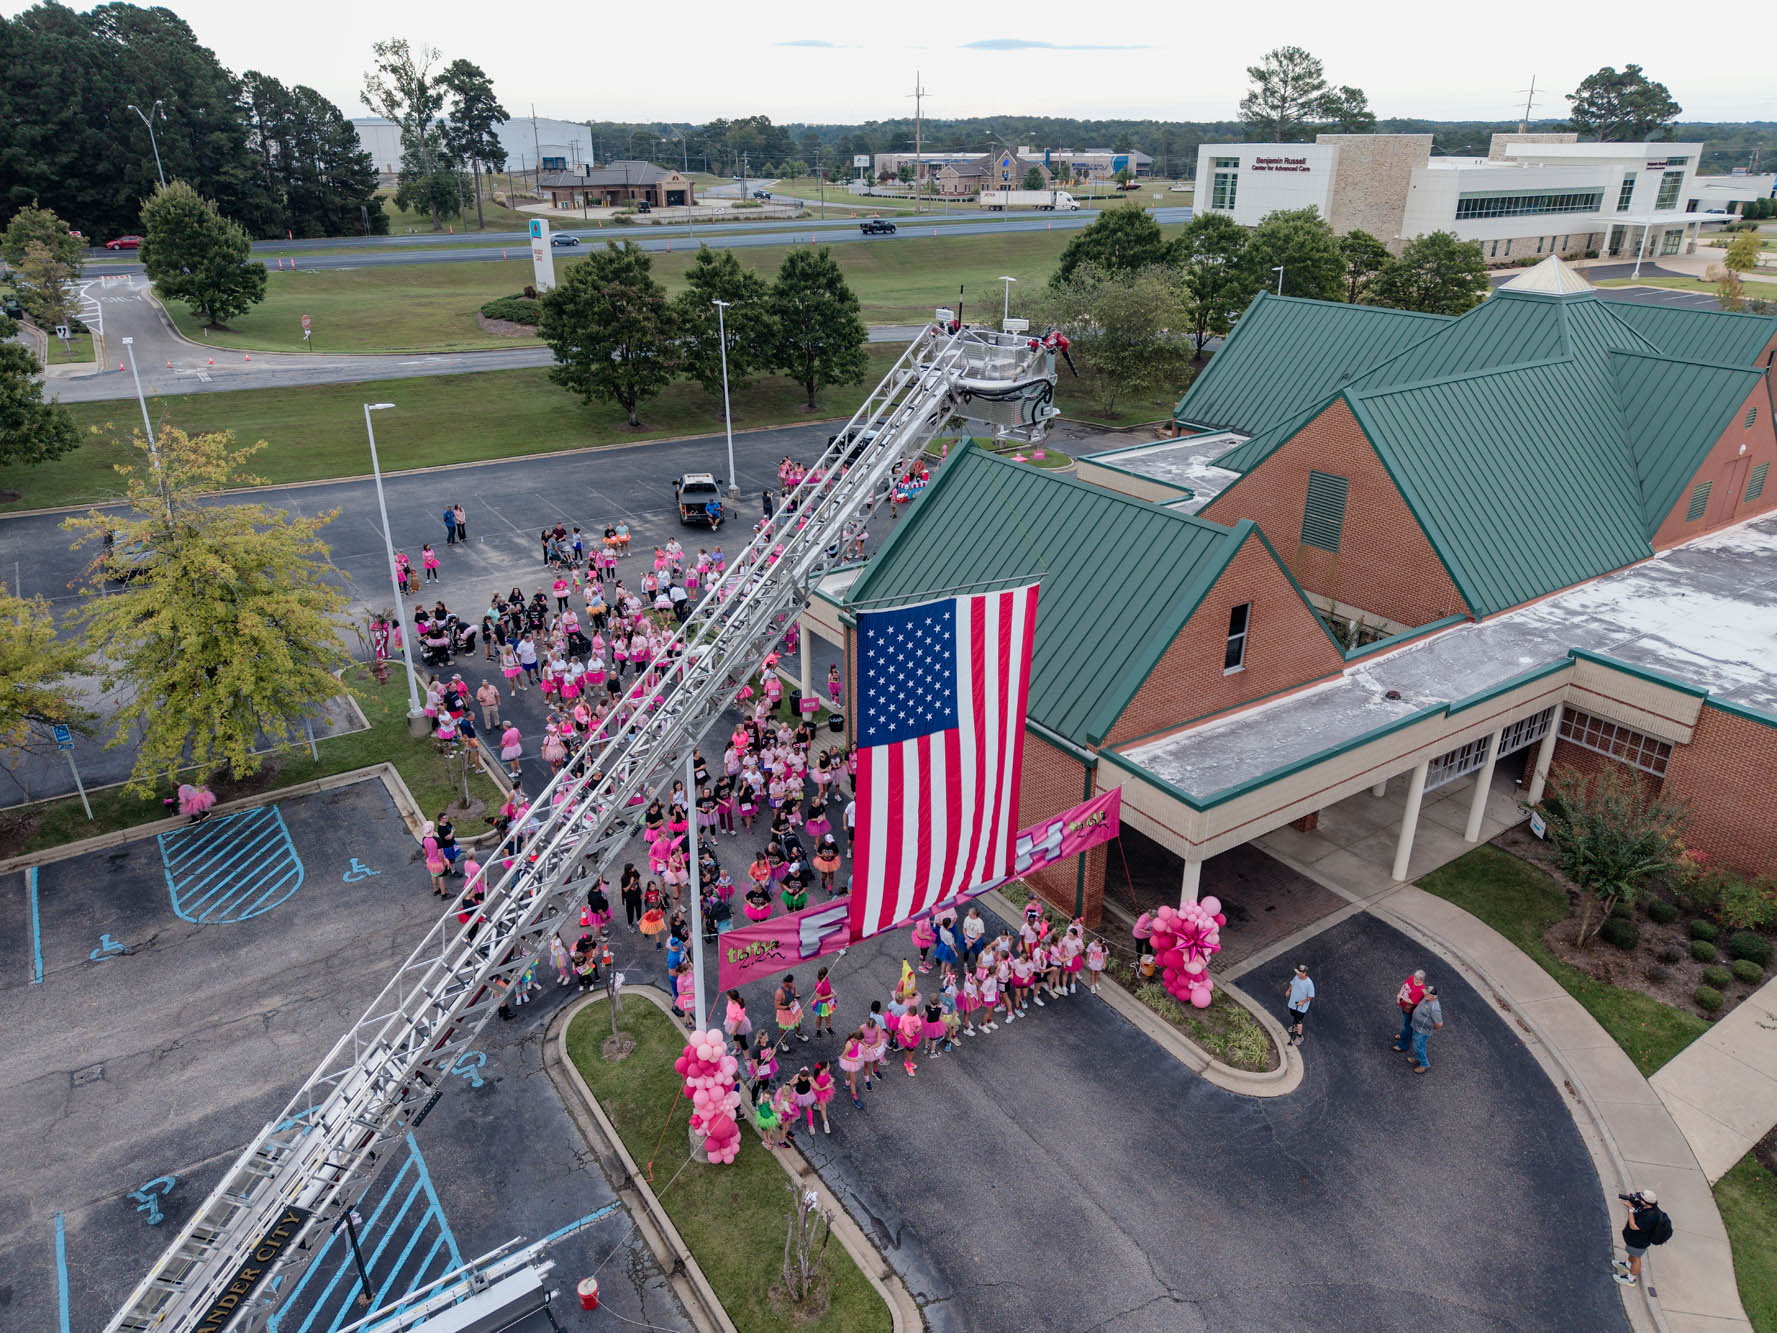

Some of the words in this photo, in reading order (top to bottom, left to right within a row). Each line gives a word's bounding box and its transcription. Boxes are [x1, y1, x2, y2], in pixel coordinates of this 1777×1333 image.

[1256, 157, 1283, 166] Benjamin
[1284, 157, 1306, 165] Russell
[256, 1211, 300, 1263] CITY
